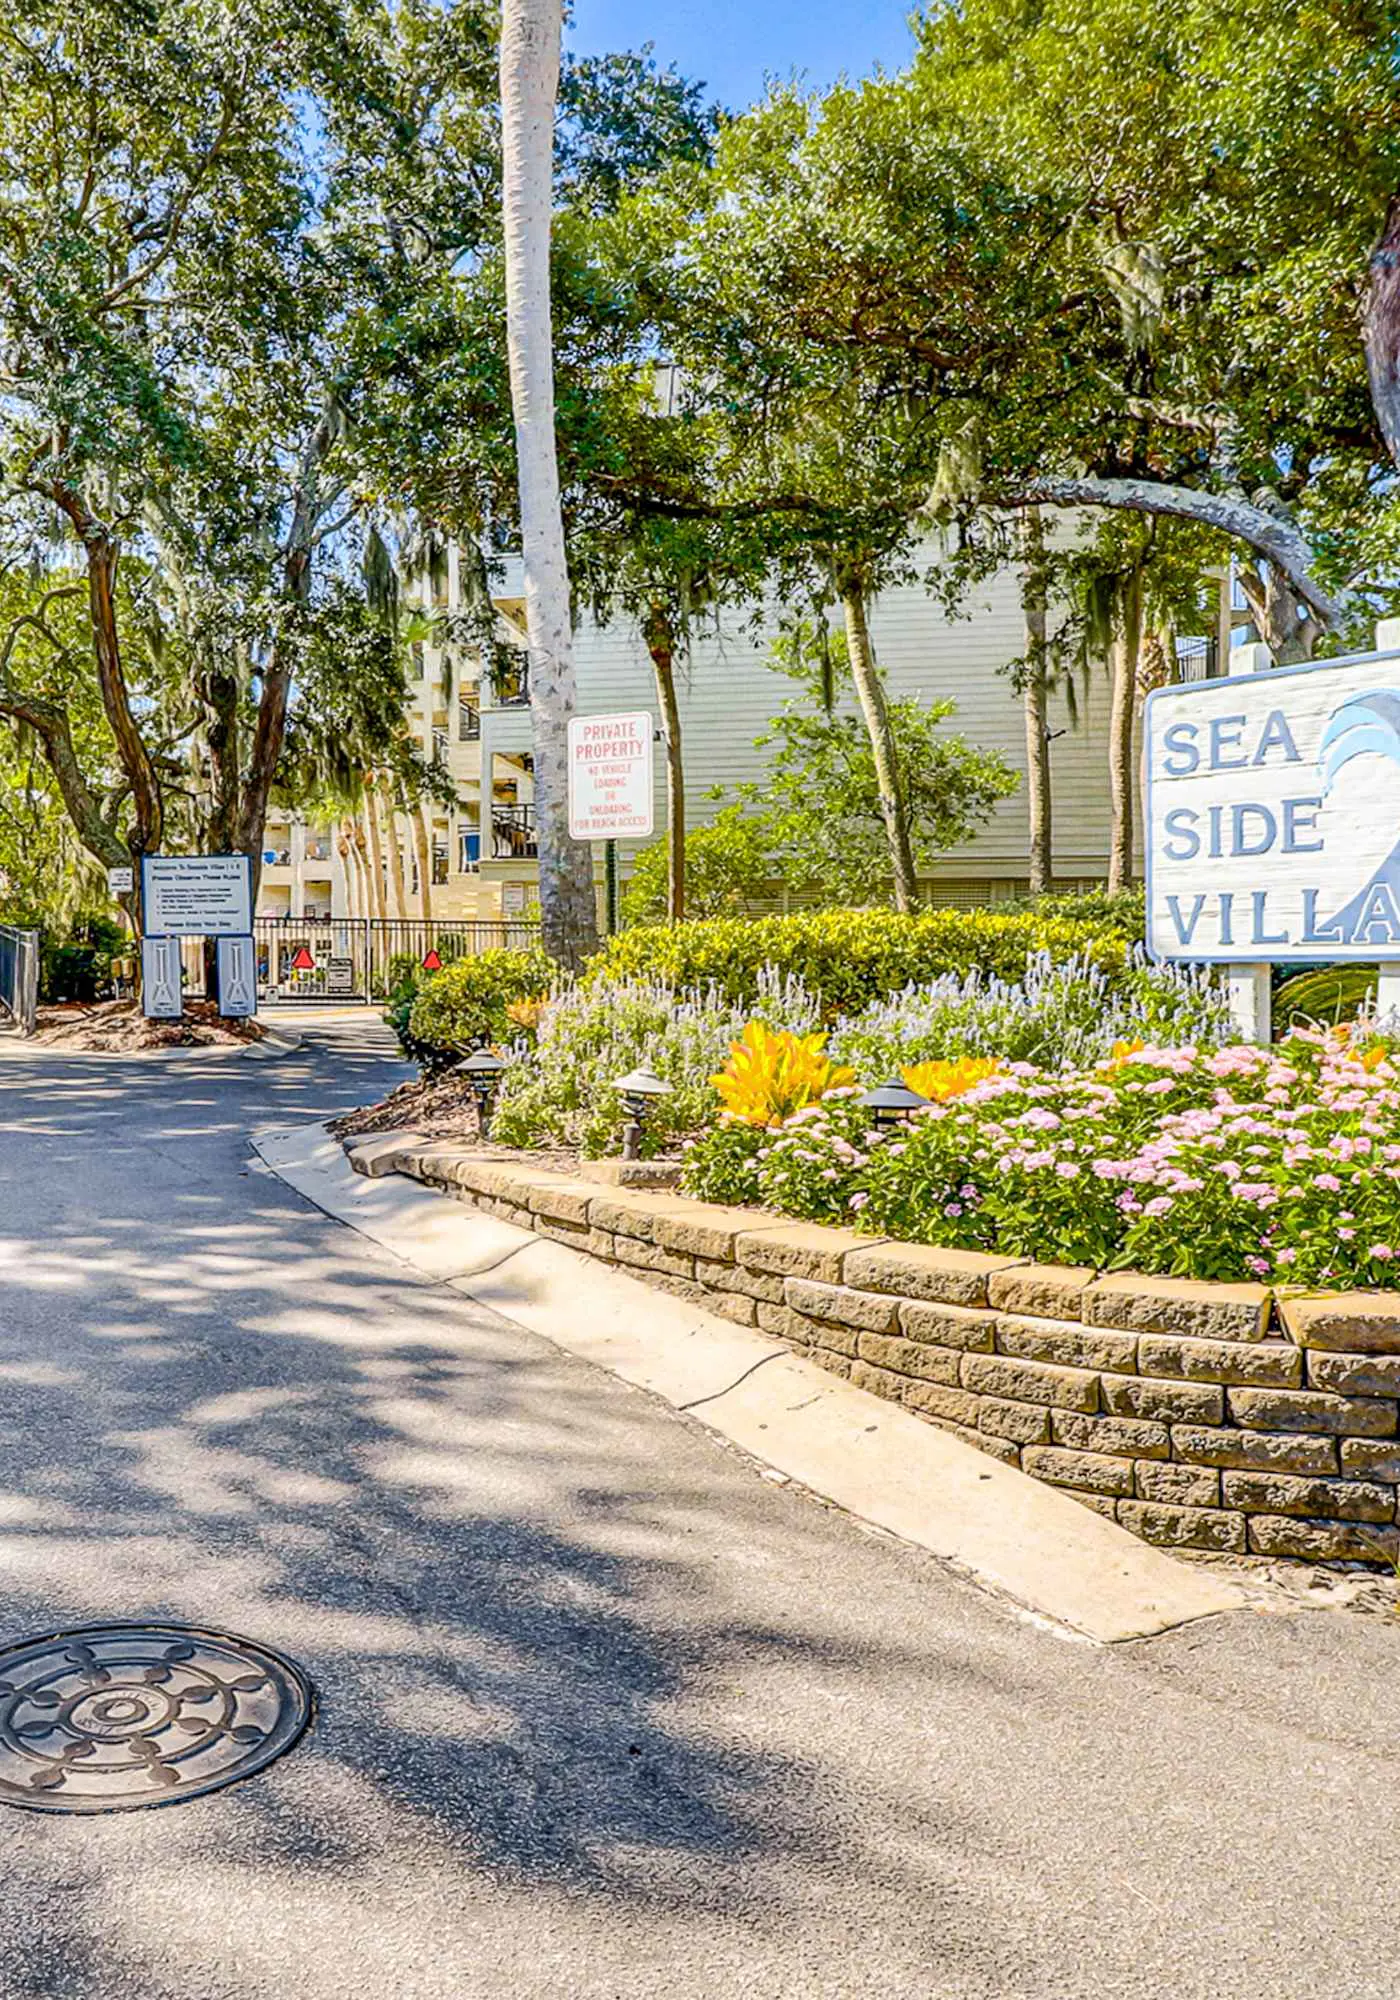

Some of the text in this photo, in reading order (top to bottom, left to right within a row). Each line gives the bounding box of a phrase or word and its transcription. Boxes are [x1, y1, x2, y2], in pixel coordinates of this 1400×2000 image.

[583, 721, 637, 741] PRIVATE
[576, 740, 645, 760] PROPERTY
[1162, 709, 1302, 776] SEA
[588, 764, 632, 776] NO VEHICLE
[594, 777, 627, 789] LOADING
[589, 803, 633, 815] UNLOADING
[619, 815, 647, 827] ACCESS
[1162, 796, 1325, 861] SIDE
[1166, 881, 1400, 946] VILLA
